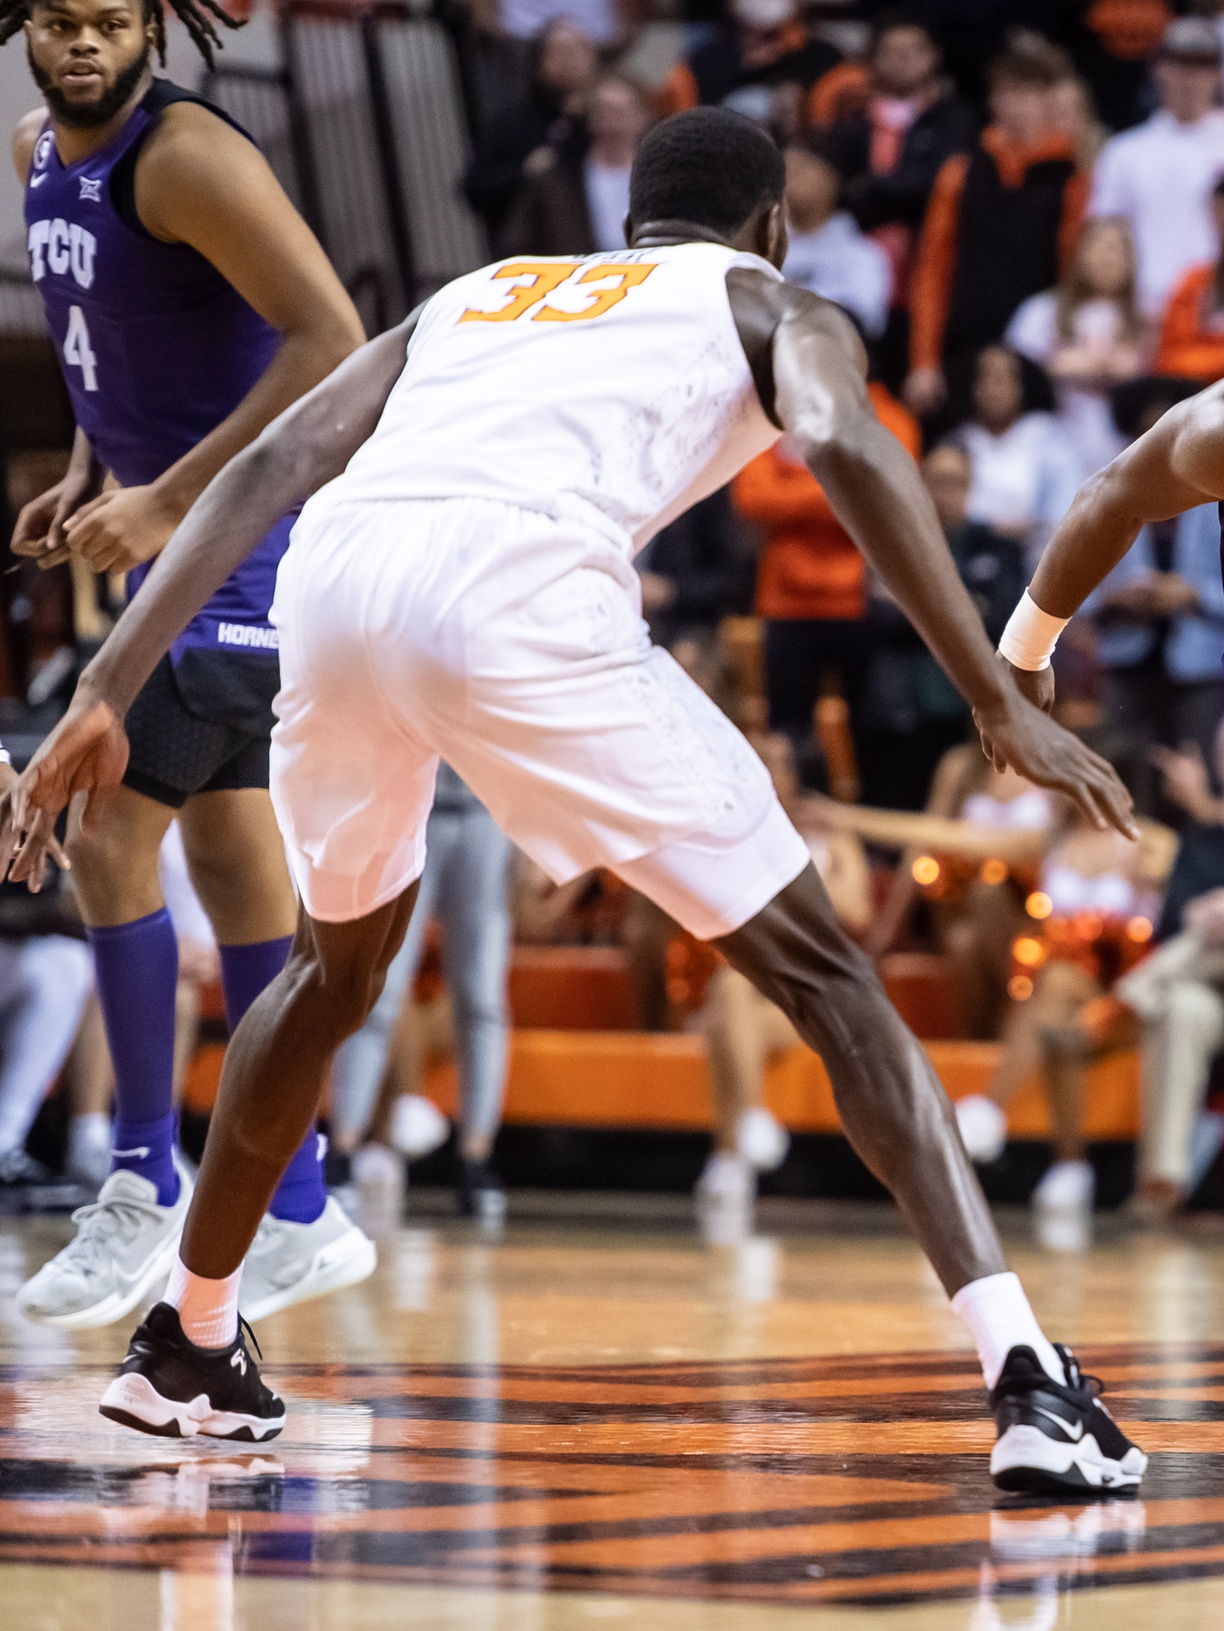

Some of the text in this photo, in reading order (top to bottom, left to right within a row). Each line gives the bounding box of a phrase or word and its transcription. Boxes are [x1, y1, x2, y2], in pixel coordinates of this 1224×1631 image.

[28, 217, 98, 289] TCU
[455, 262, 660, 325] 33
[63, 305, 99, 391] 4
